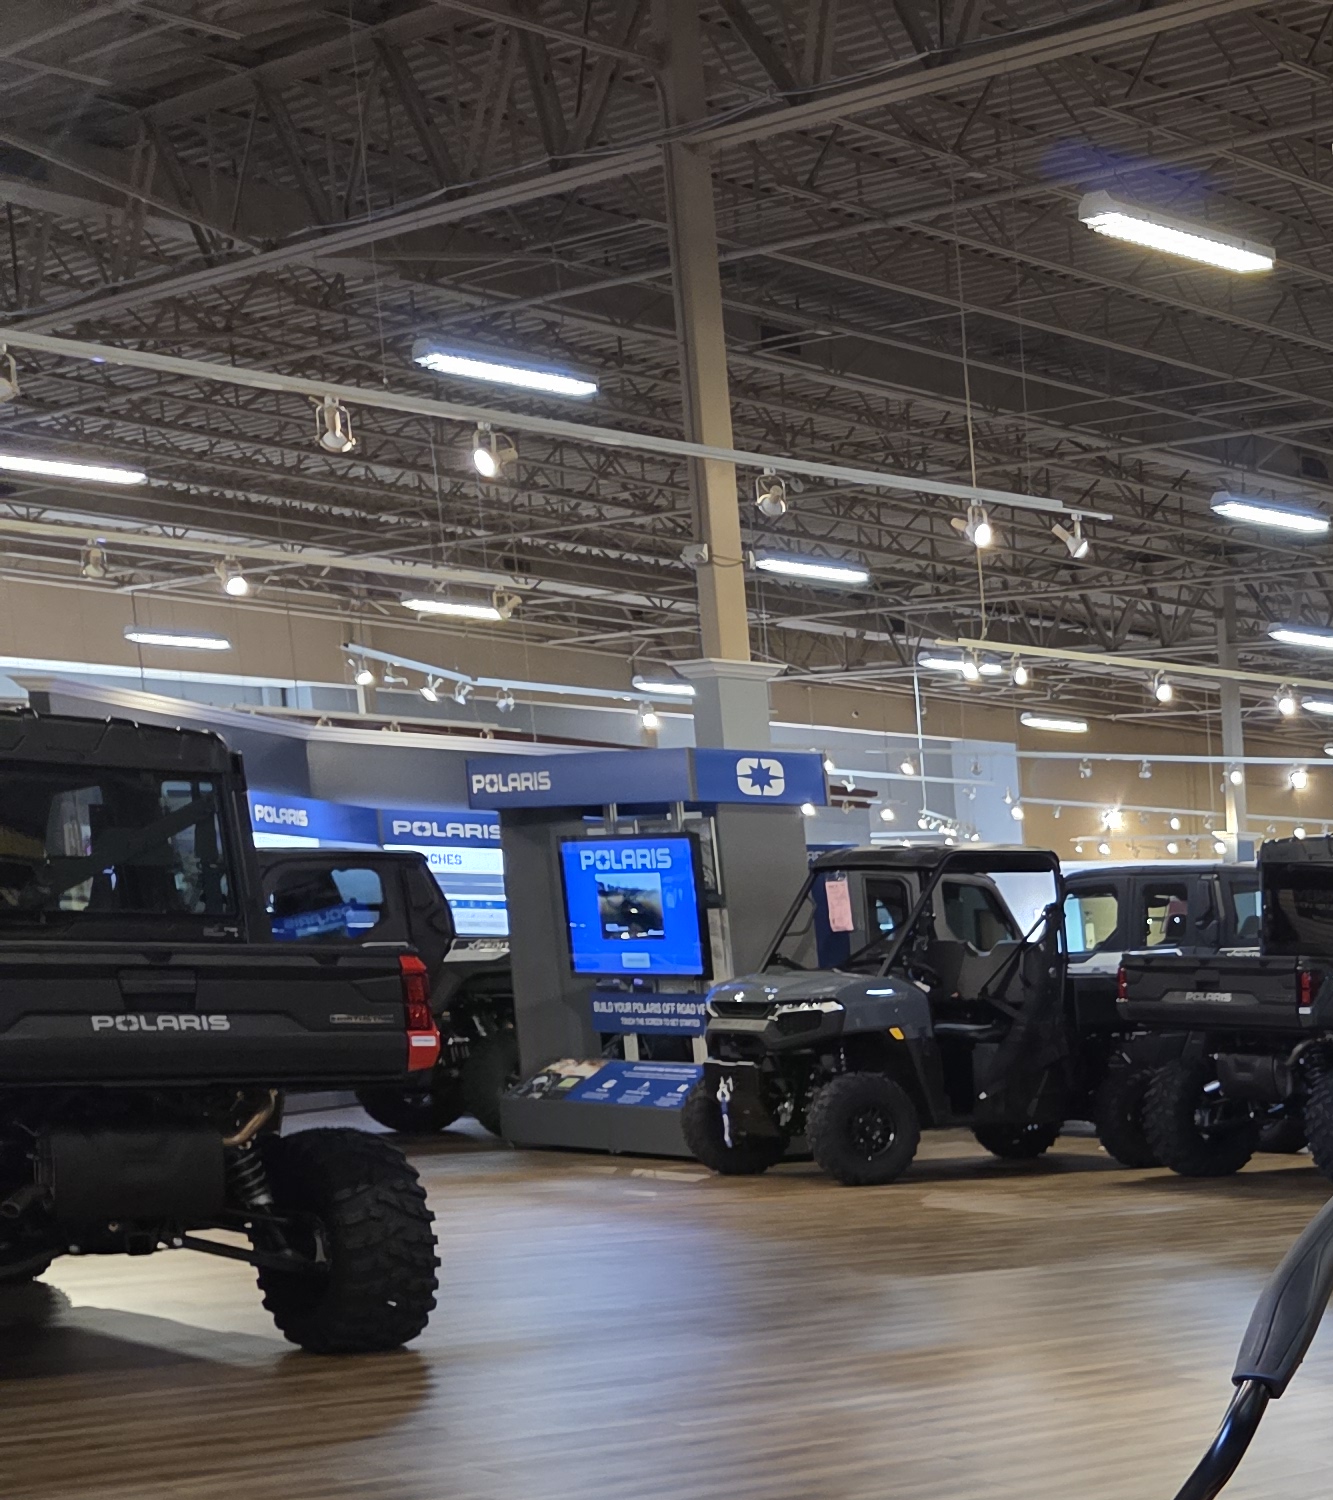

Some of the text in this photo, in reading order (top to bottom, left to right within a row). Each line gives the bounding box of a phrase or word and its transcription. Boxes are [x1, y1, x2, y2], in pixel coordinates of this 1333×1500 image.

[472, 770, 551, 794] POLARIS
[254, 804, 309, 827] POLARIS
[393, 820, 501, 839] POLARIS
[426, 853, 462, 866] CHES
[580, 848, 672, 870] POLARIS
[1185, 992, 1232, 1002] POLARIS
[632, 1002, 661, 1014] POLARIS
[662, 1003, 675, 1014] OFF
[91, 1015, 231, 1031] POLARIS
